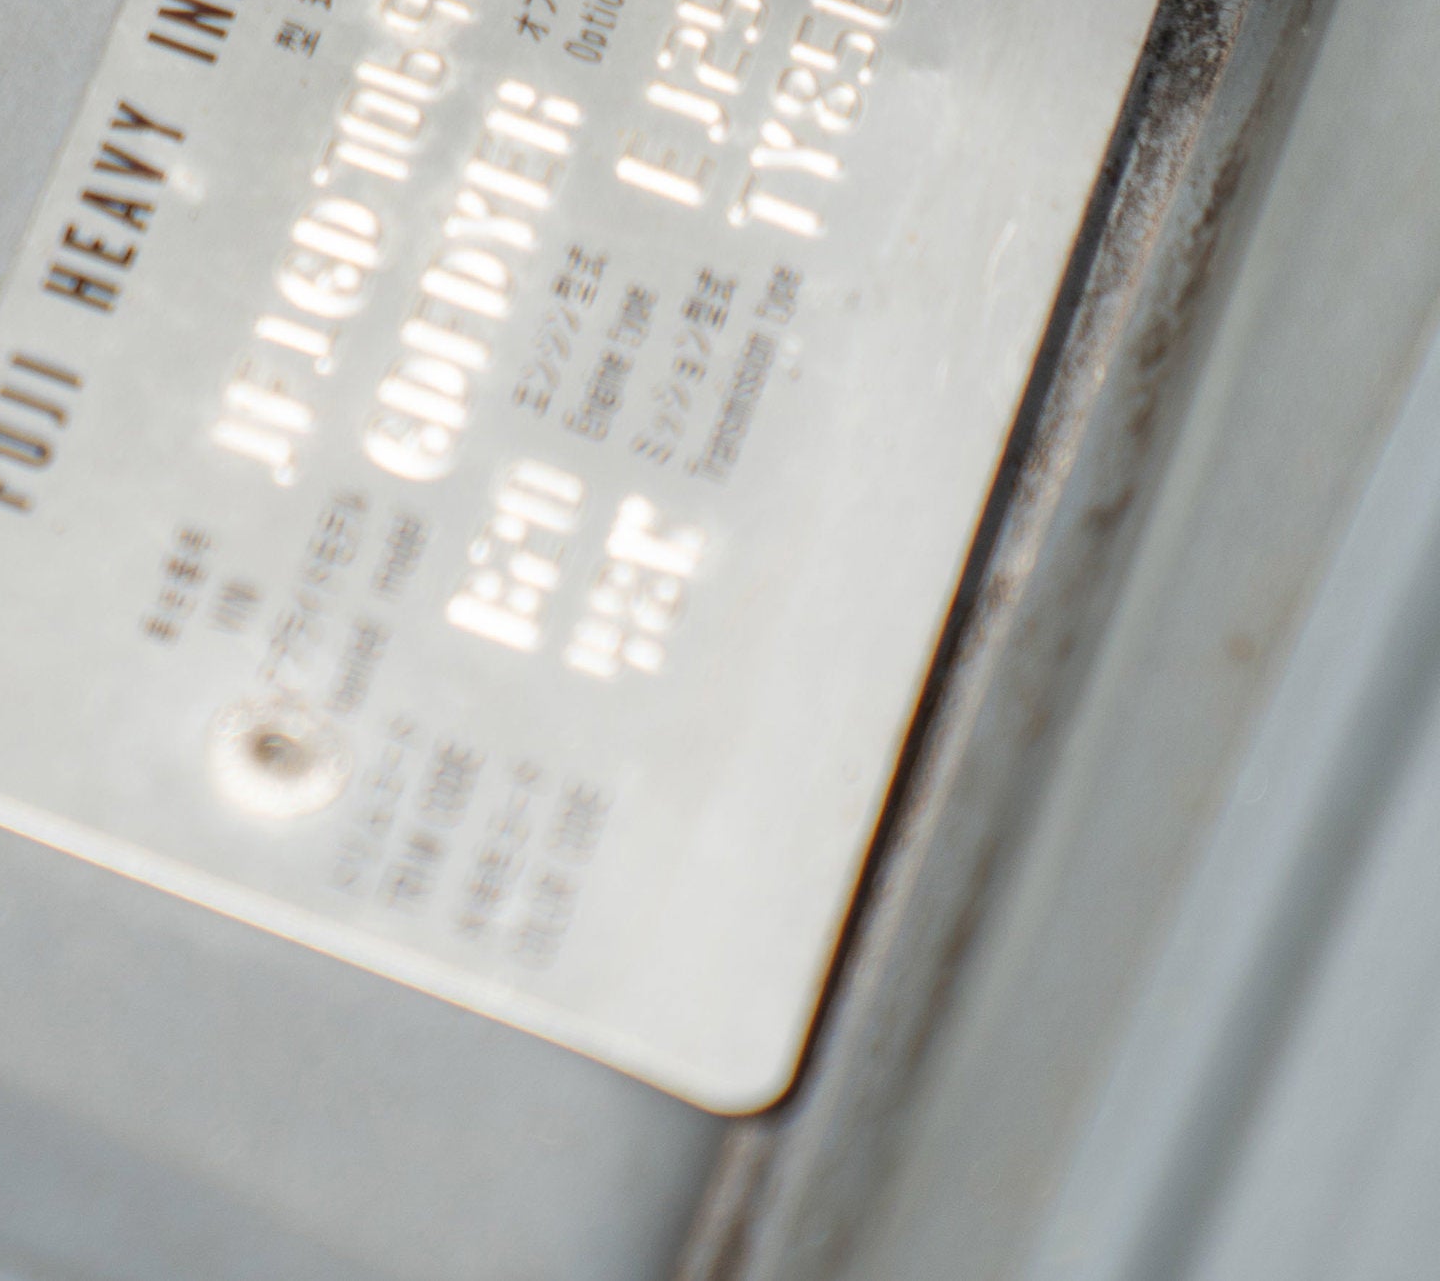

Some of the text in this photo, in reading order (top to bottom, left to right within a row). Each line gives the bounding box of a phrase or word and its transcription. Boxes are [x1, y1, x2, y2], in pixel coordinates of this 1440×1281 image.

[42, 98, 188, 313] HEAVY
[564, 281, 659, 442] Engine type
